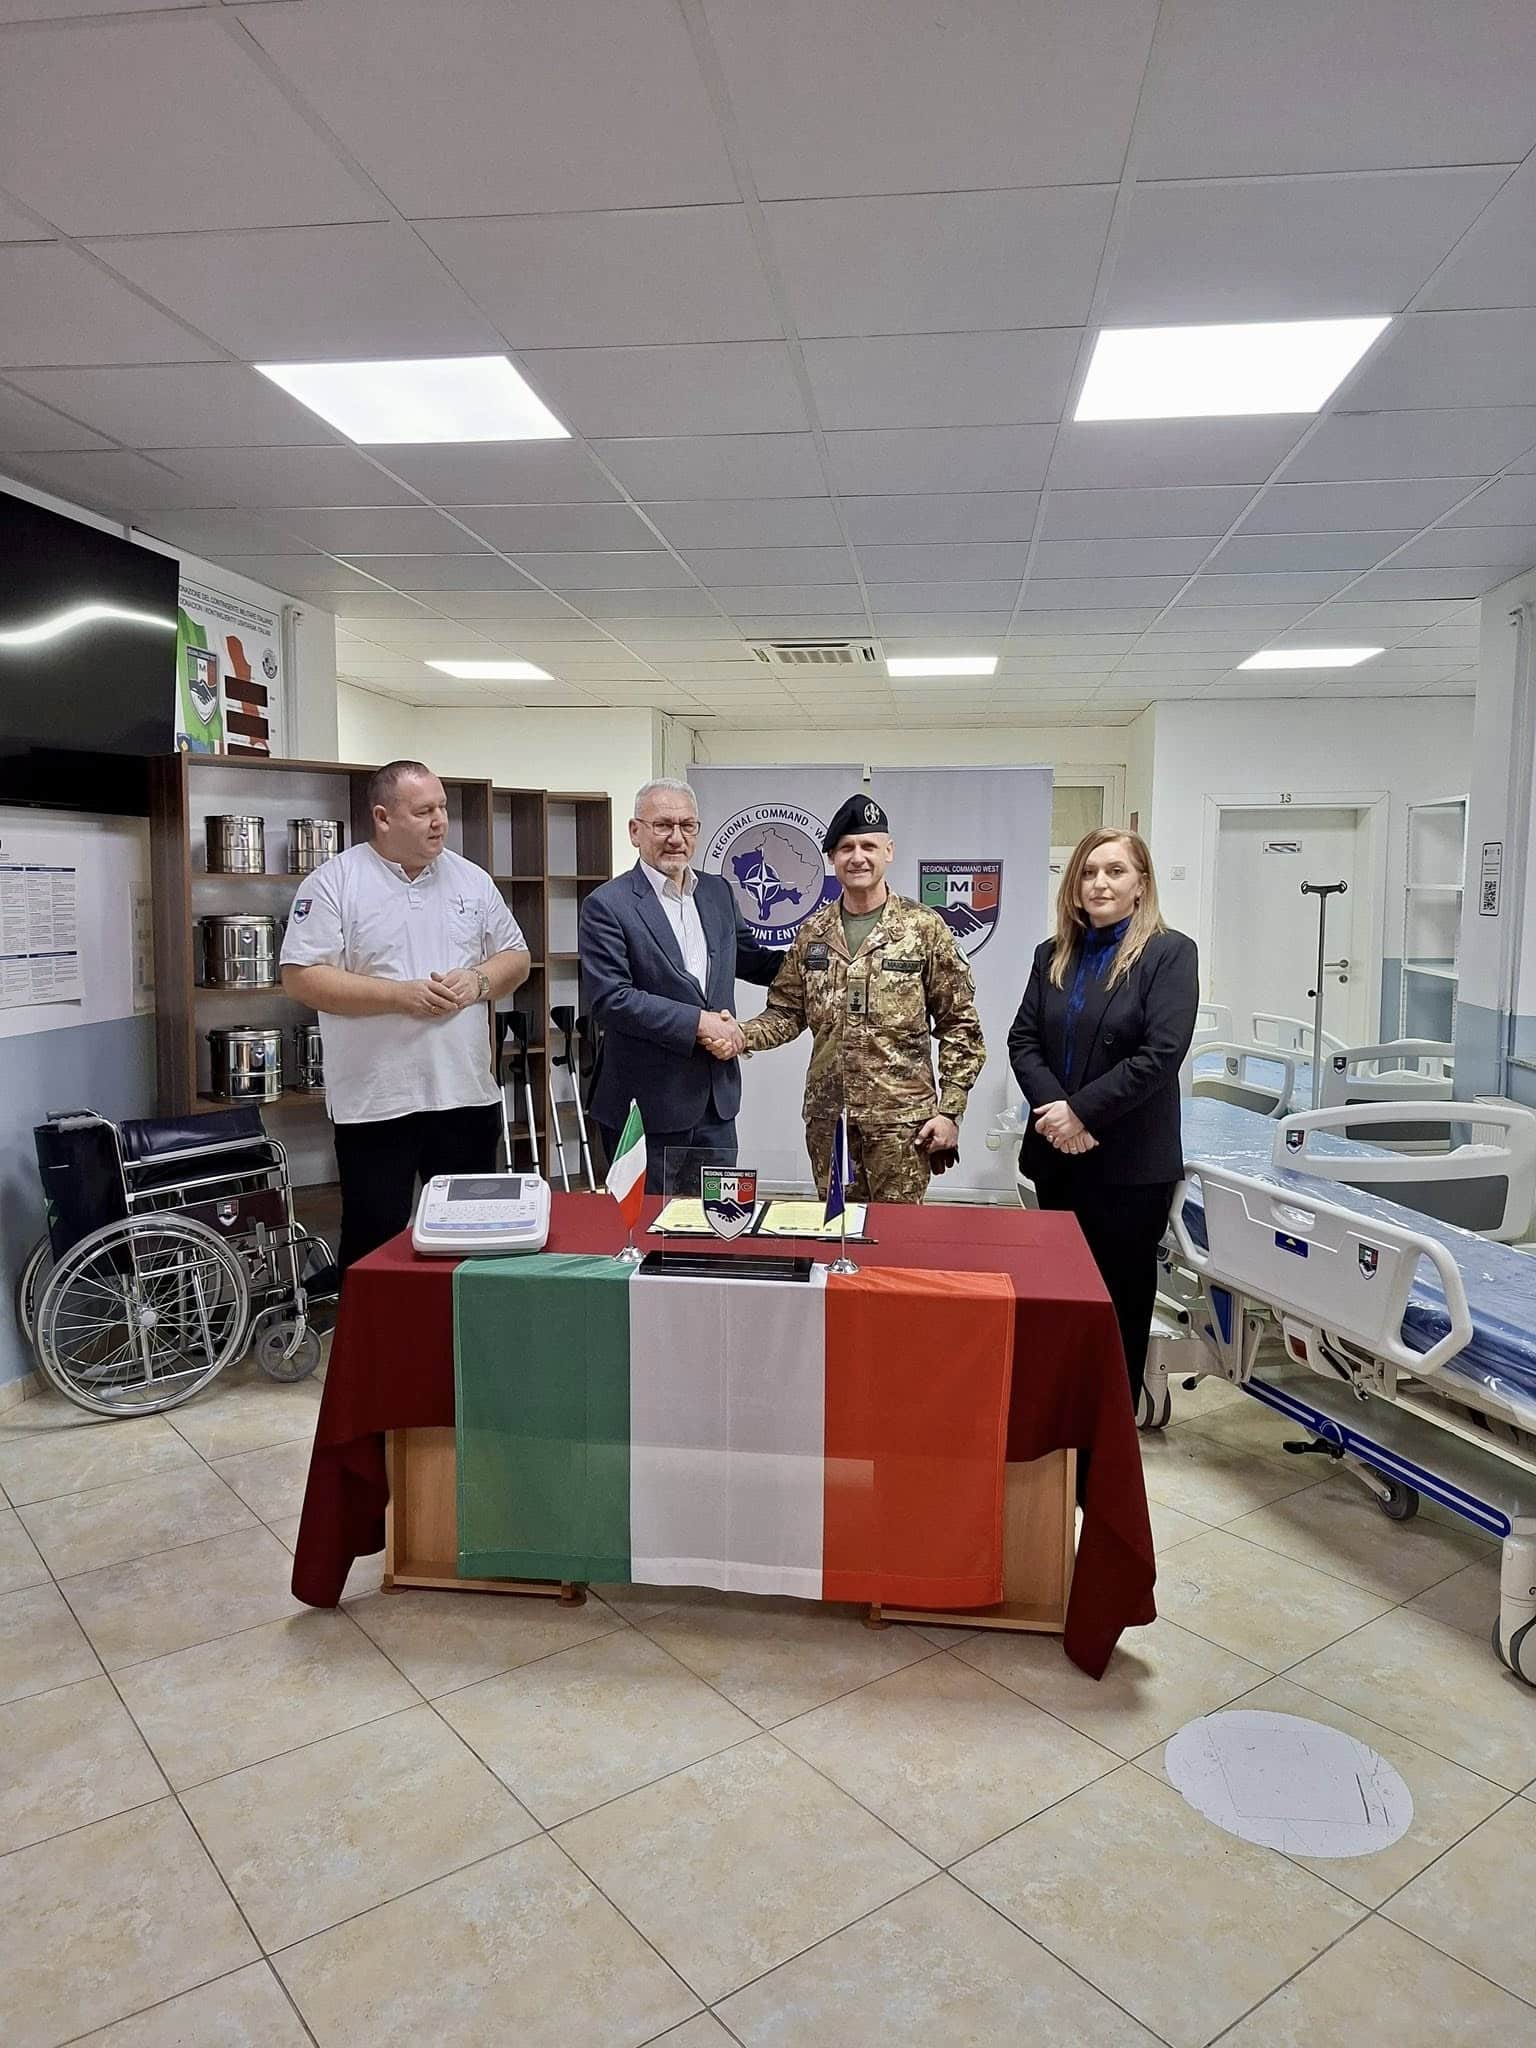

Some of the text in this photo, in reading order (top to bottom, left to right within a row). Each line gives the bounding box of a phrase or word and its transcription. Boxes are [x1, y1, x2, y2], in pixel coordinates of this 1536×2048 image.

[1280, 793, 1292, 804] 13
[711, 814, 753, 859] REGIONAL
[755, 809, 809, 826] COMMAND
[922, 865, 999, 873] REGIONAL COMMAND WEST
[926, 881, 993, 891] CIMIC
[706, 1181, 752, 1191] CIMIC
